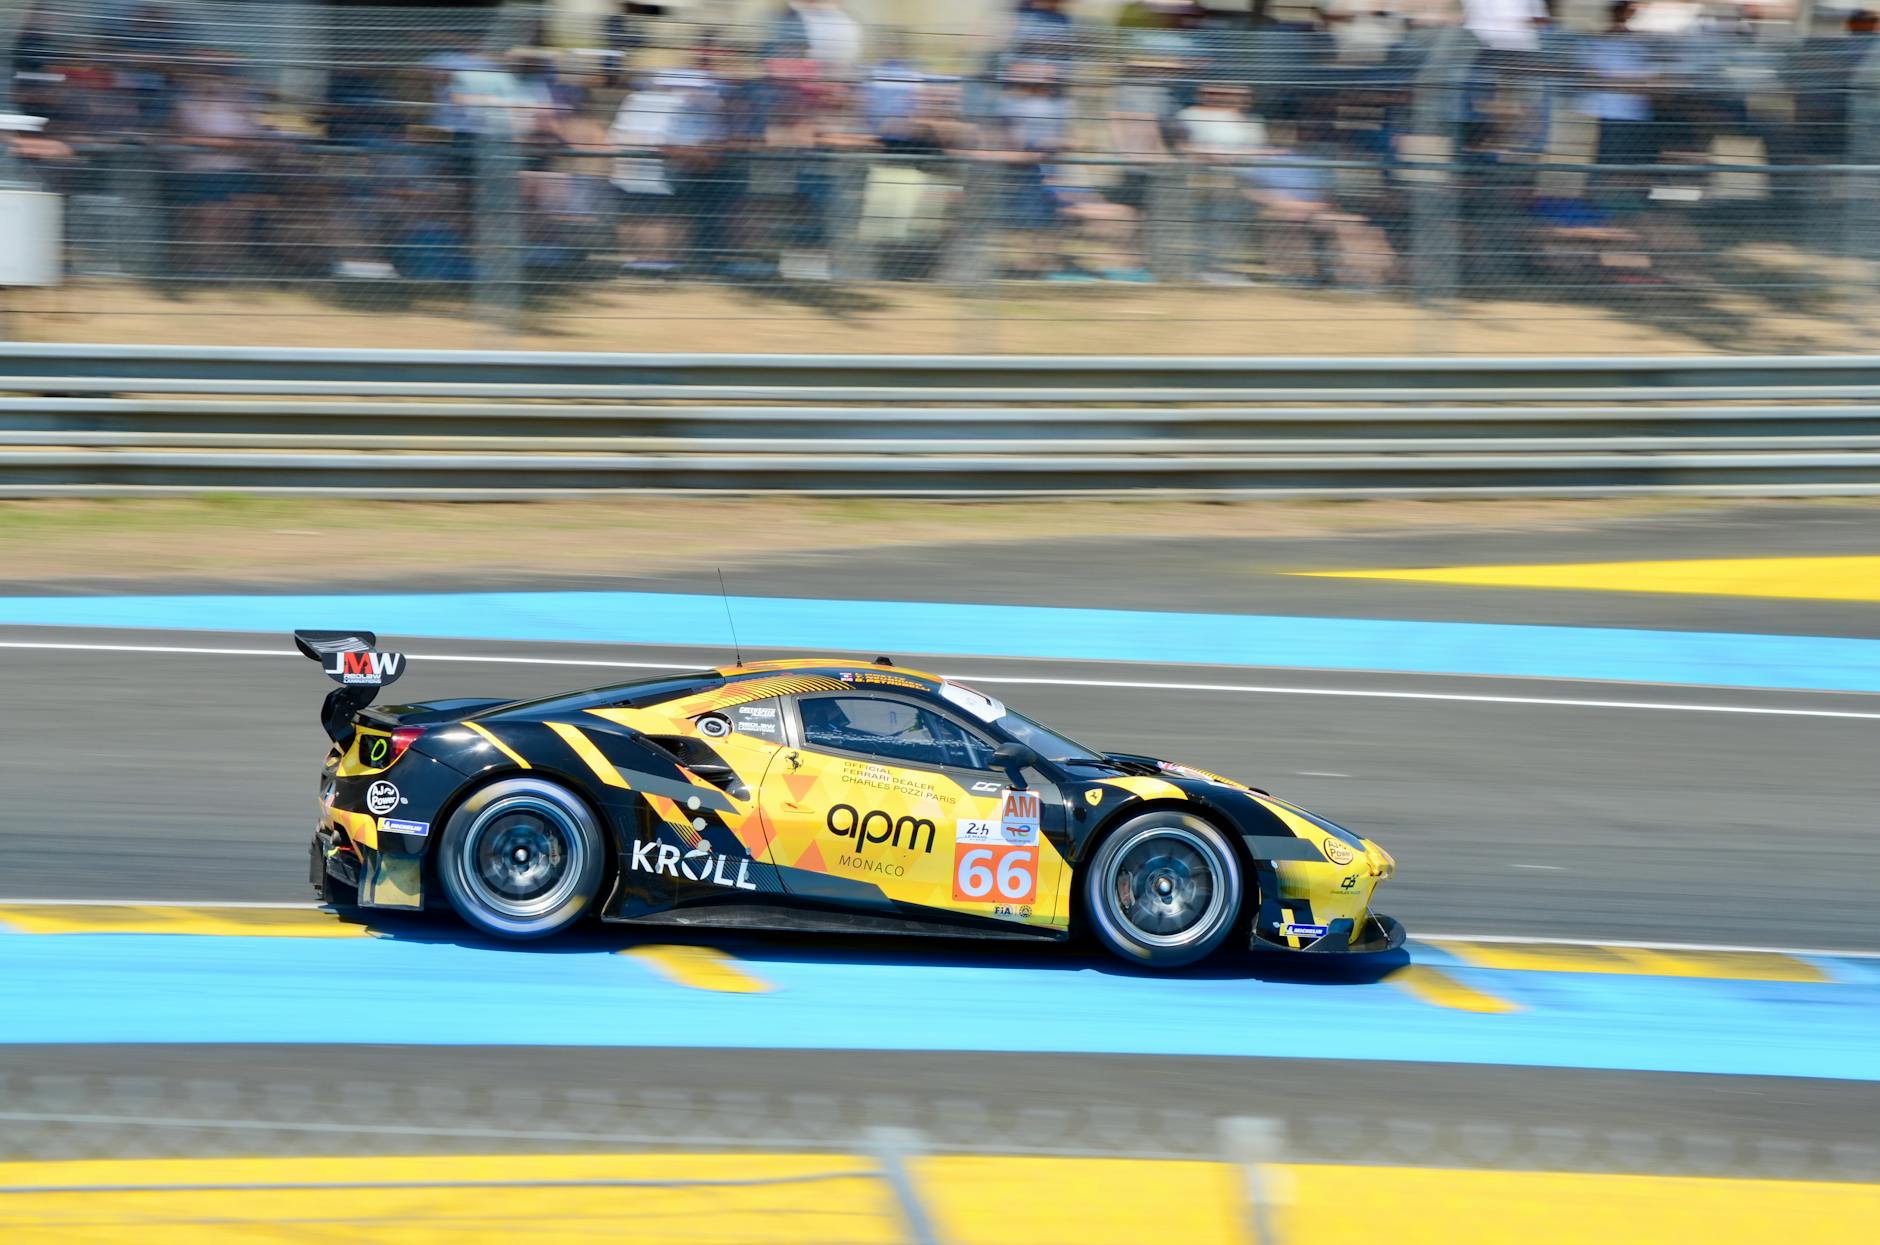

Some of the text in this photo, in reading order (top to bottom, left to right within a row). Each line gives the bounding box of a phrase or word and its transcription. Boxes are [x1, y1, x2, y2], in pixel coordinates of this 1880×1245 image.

[325, 652, 400, 675] JMW
[843, 768, 935, 791] FERRARI DEALER
[844, 761, 893, 775] OFFICIAL
[372, 796, 396, 807] Power
[841, 775, 956, 805] CHARLES POZZI PARIS
[1004, 795, 1037, 818] AM
[826, 803, 936, 853] apm
[839, 854, 905, 877] MONACO
[958, 848, 1033, 899] 66
